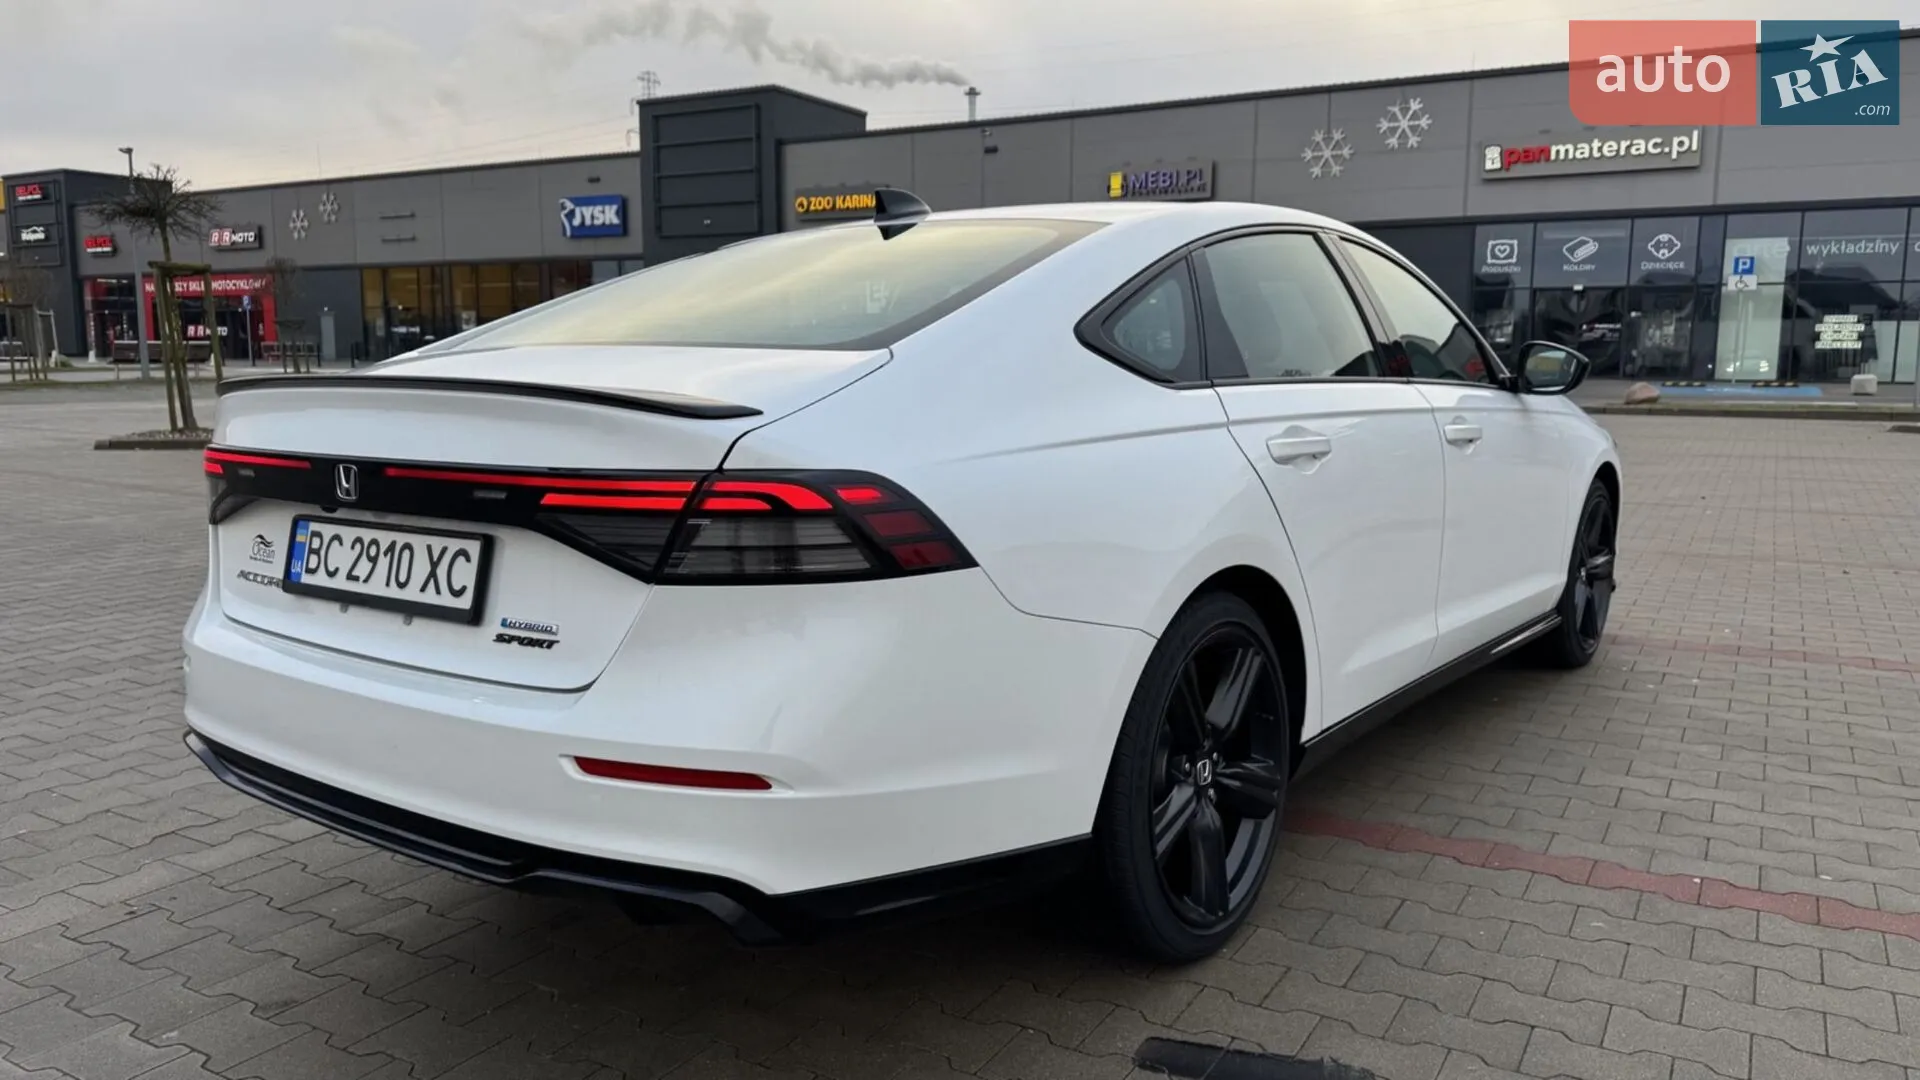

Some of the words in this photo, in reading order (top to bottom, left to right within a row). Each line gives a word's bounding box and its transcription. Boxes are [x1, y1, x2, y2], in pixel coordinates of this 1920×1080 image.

[1503, 129, 1699, 171] panmaterac.pl
[809, 195, 834, 211] ZOO
[571, 204, 620, 227] JYSK
[231, 231, 255, 243] MOTO
[1805, 239, 1901, 257] wykładziny
[1738, 258, 1751, 273] P
[291, 559, 302, 573] UA
[305, 530, 343, 578] BC
[346, 536, 414, 590] 2910
[420, 544, 471, 598] XC
[508, 620, 554, 633] HYBRID
[493, 633, 560, 650] SPORT
